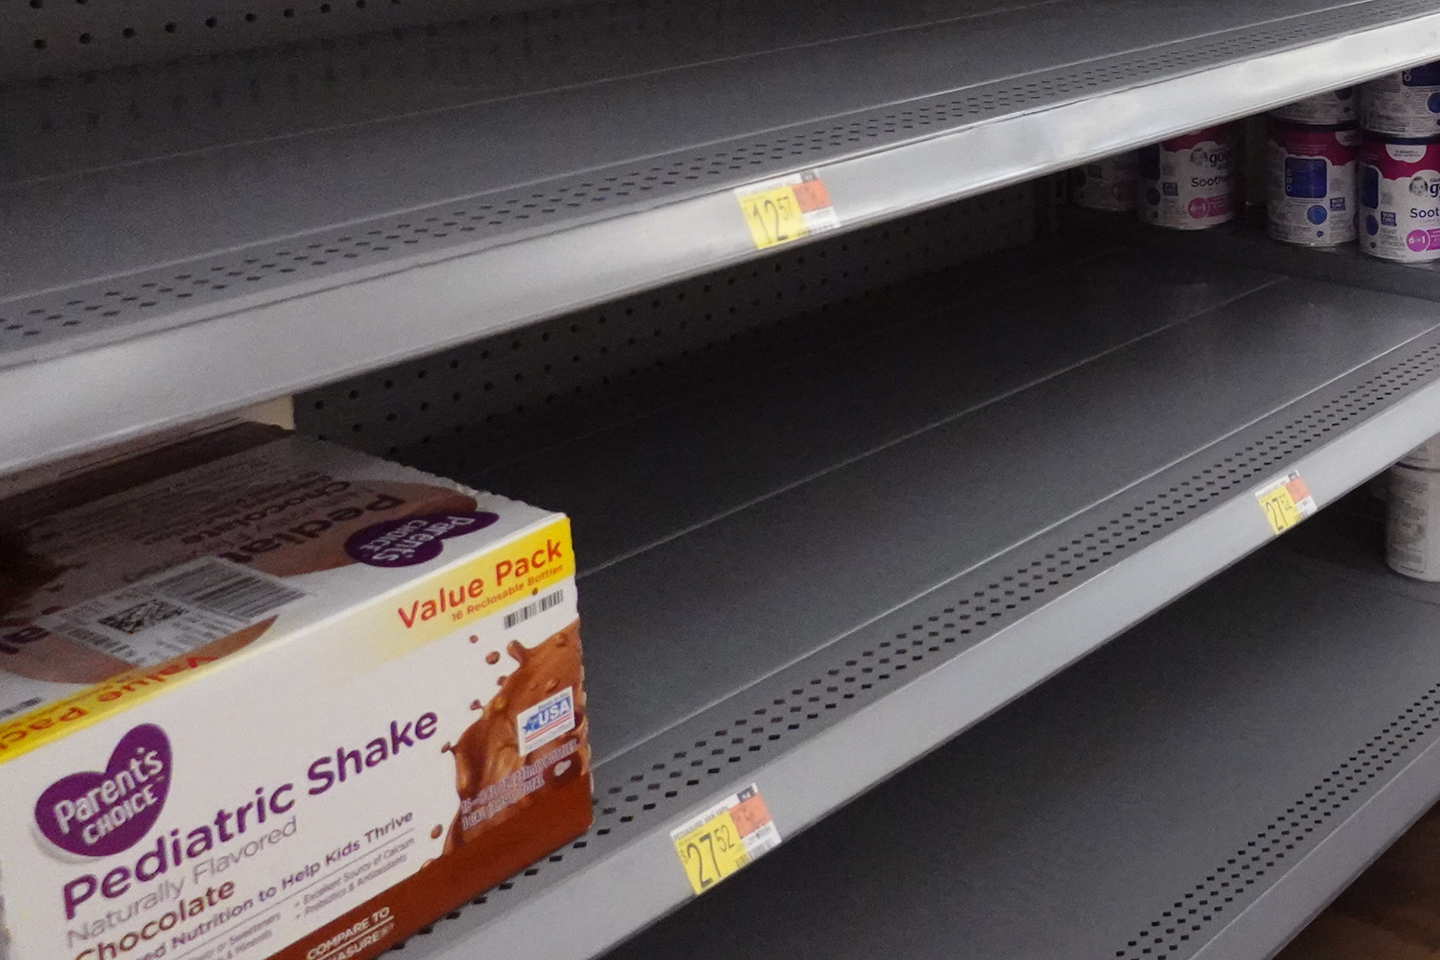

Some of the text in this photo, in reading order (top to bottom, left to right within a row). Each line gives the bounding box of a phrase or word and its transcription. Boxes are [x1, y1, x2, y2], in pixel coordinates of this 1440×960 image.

[397, 538, 563, 629] Value Pack
[451, 563, 564, 623] 16 Reclosable Bottles
[0, 705, 90, 752] Pac
[538, 697, 573, 726] USA
[52, 745, 164, 835] Parent's
[62, 782, 297, 921] Pediatric
[306, 709, 440, 797] Shake
[81, 782, 159, 847] CHOICE
[65, 814, 299, 949] Naturally Flavored
[170, 811, 415, 949] Nutrition to Help Kids Thrive
[342, 860, 373, 884] Source
[383, 836, 416, 860] Calcium
[305, 905, 392, 960] COMPARE TO
